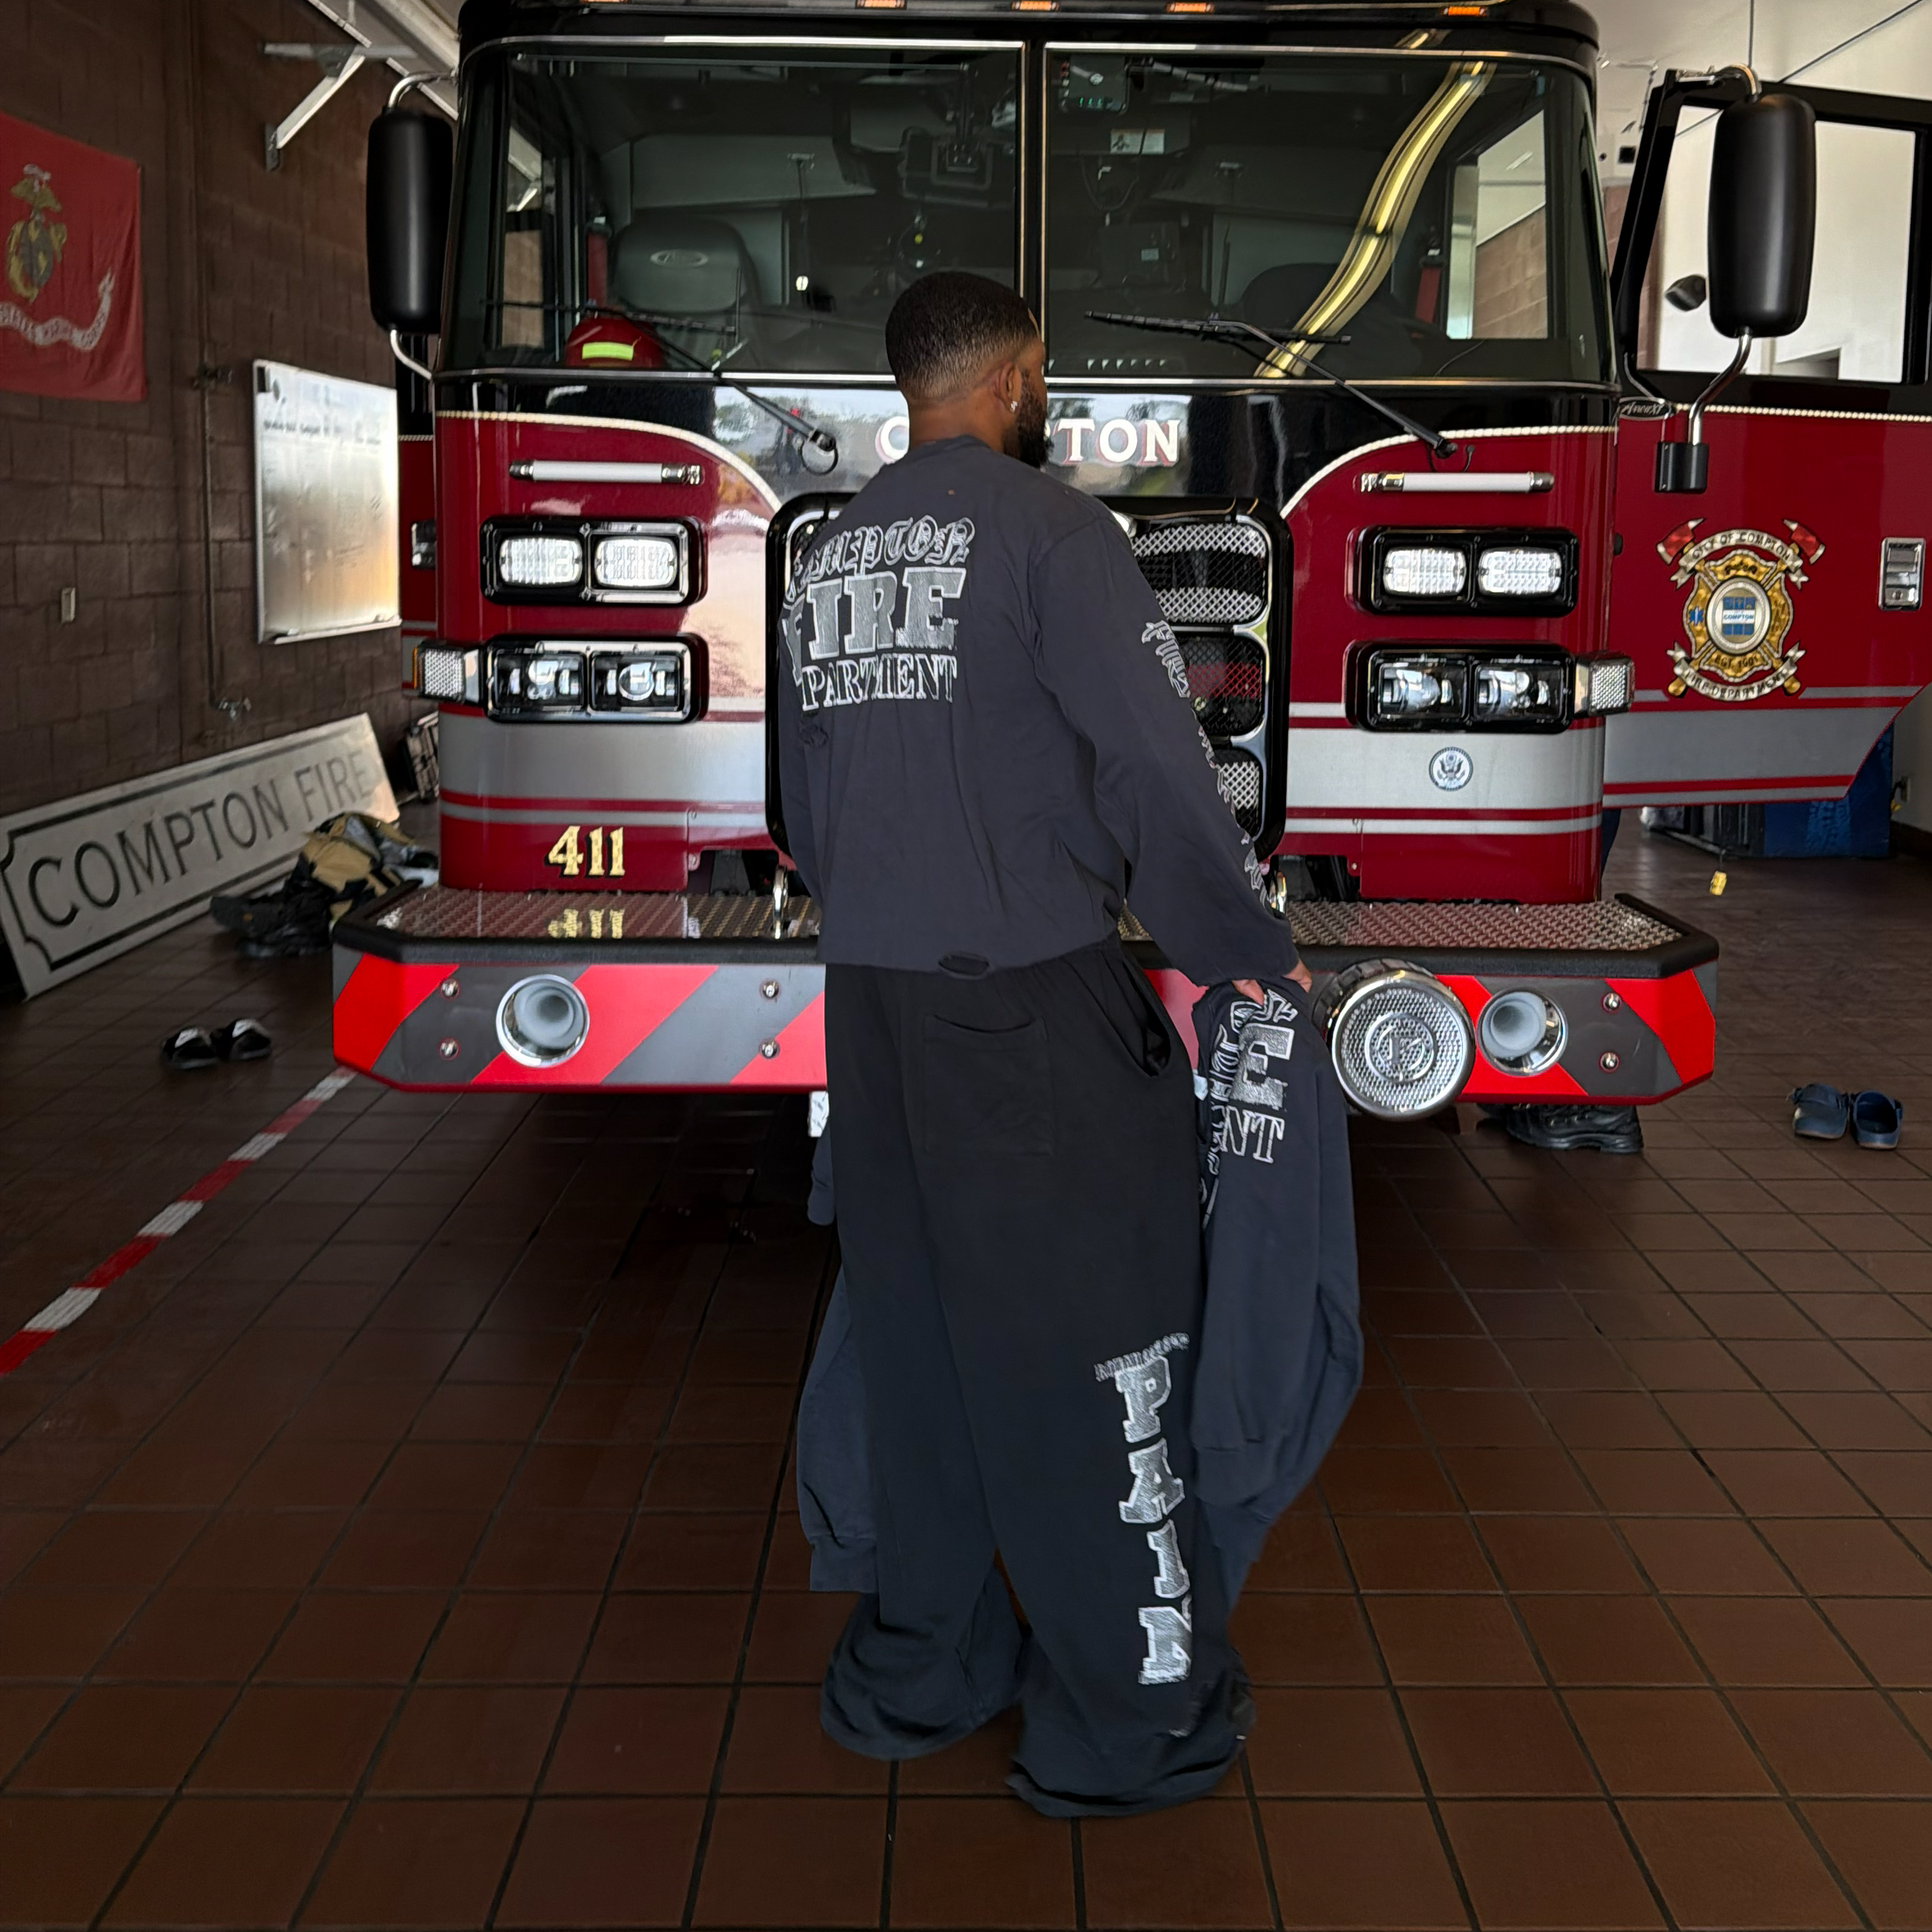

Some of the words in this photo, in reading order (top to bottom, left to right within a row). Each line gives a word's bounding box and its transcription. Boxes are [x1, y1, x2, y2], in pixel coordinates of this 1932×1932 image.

[875, 415, 1180, 468] CTON
[1692, 538, 1714, 560] CITY
[1720, 533, 1734, 545] OF
[1739, 531, 1792, 560] COMPTON
[28, 777, 289, 927] COMPTON
[295, 749, 376, 822] FIRE
[545, 825, 626, 877] 411
